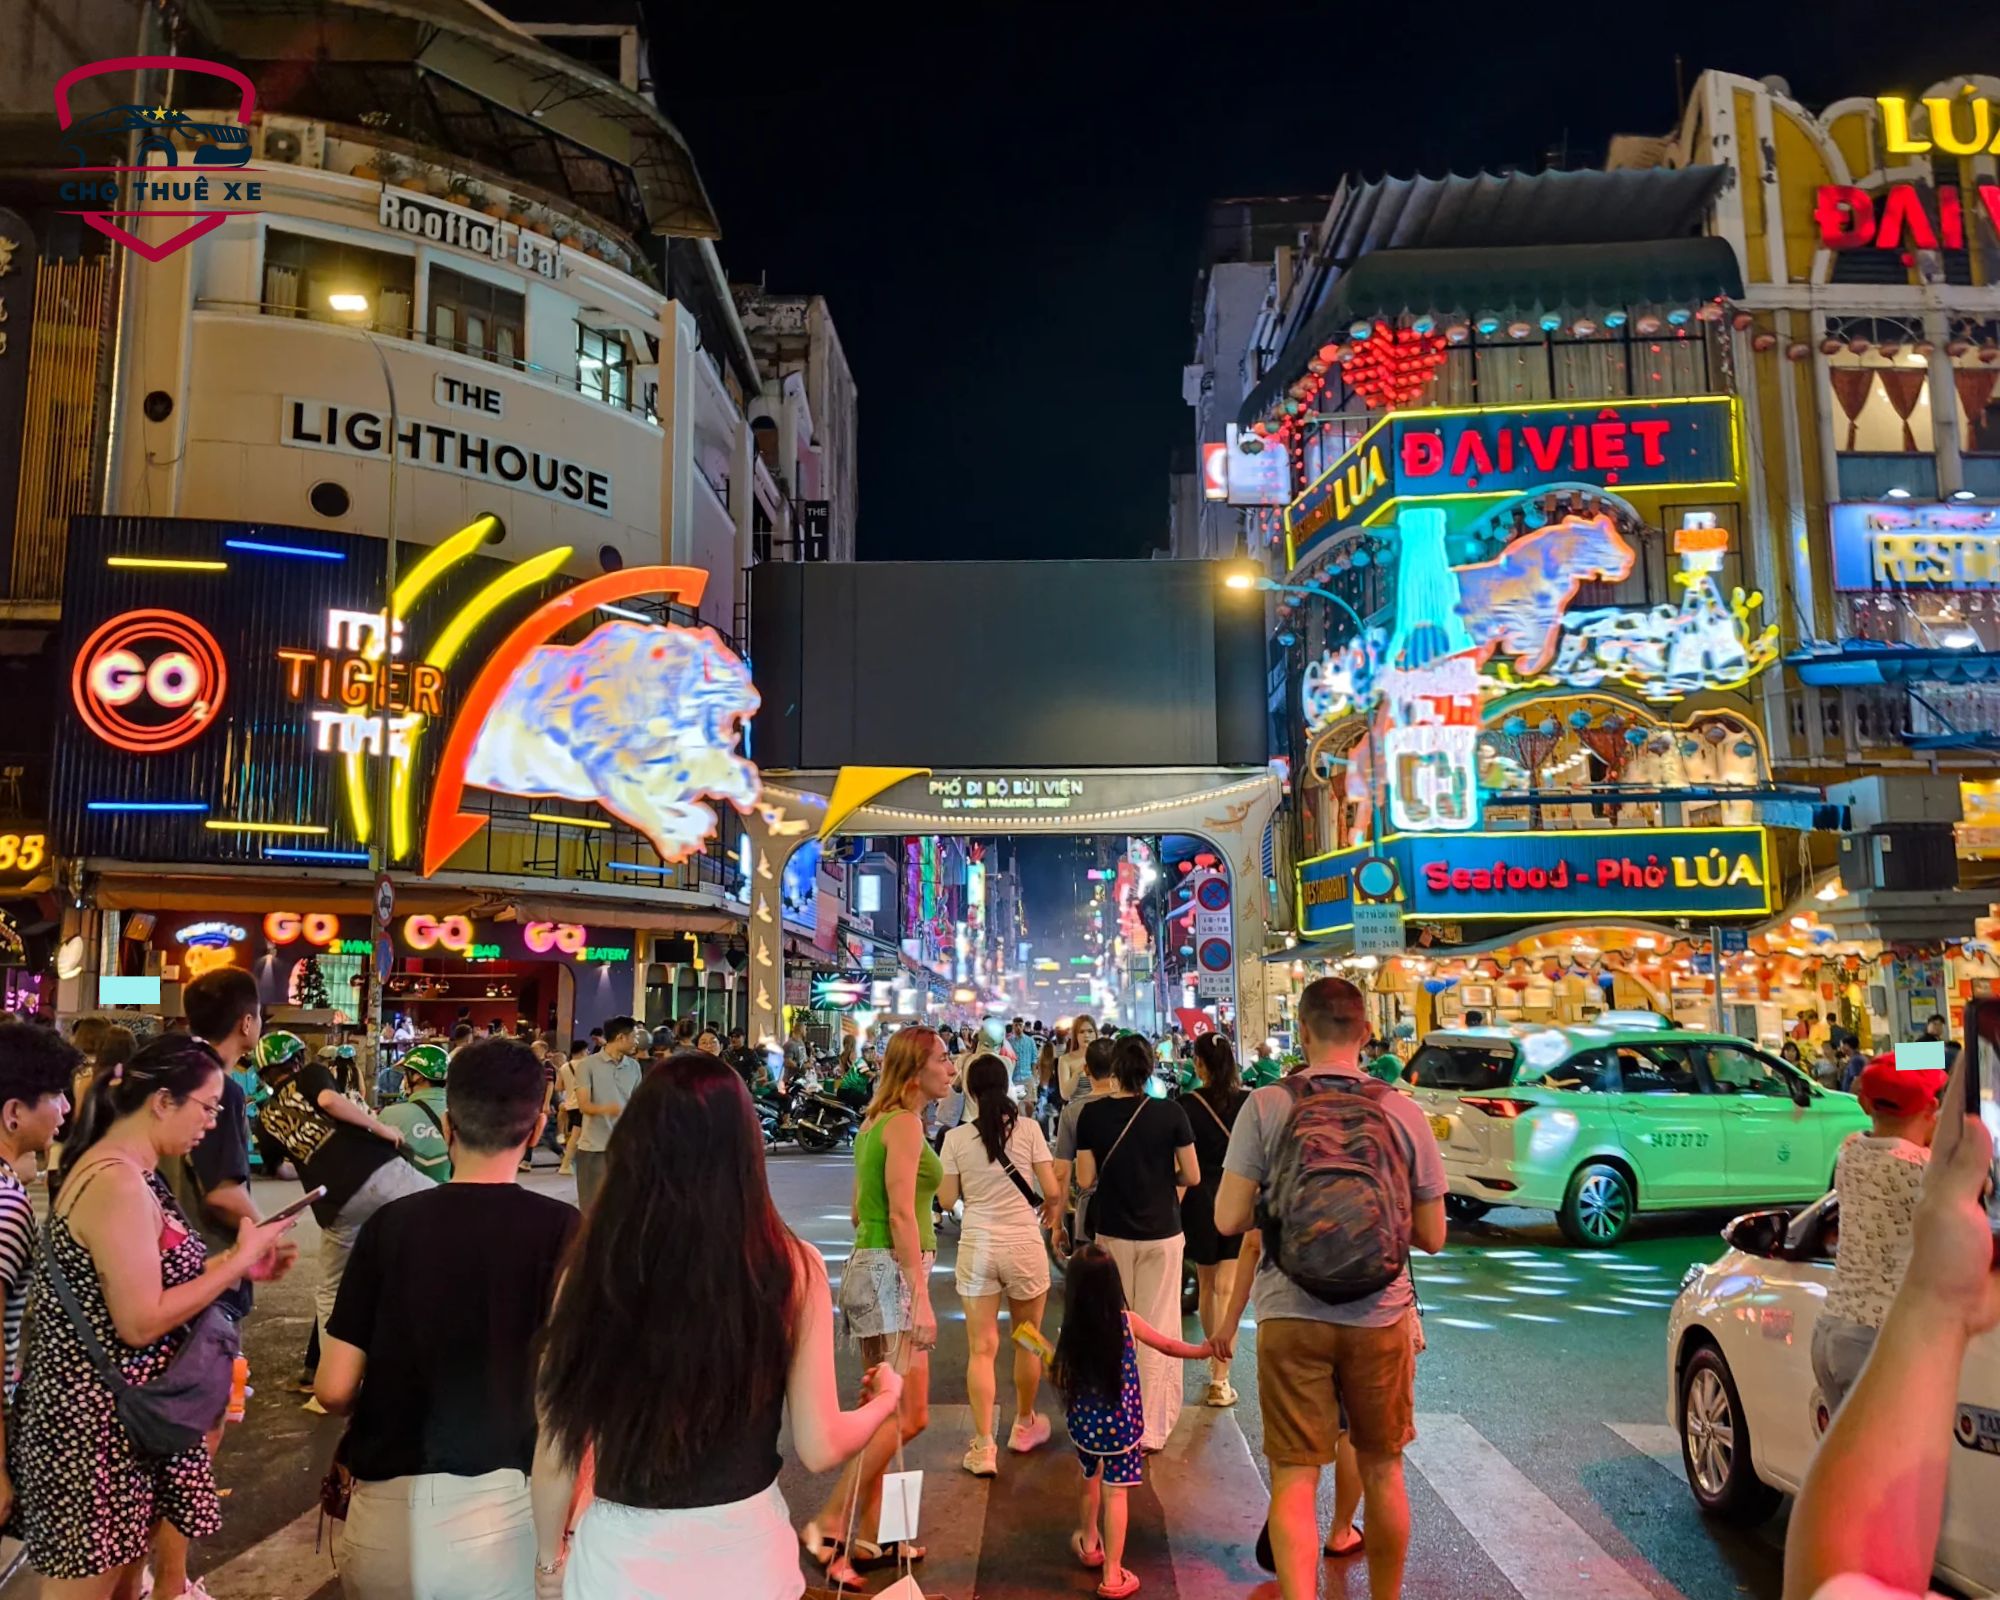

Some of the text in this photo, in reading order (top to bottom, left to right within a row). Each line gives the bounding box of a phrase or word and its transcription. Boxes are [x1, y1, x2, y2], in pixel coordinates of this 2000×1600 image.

[1876, 84, 2000, 155] LÚ
[379, 193, 566, 281] Rooftop Bar
[1814, 184, 1963, 268] ĐẠI
[443, 377, 501, 414] THE
[292, 402, 609, 510] LIGHTHOUSE
[1400, 407, 1671, 488] ĐẠI VIỆT
[807, 507, 828, 517] THE
[88, 649, 201, 708] GO
[276, 649, 444, 716] TIGER
[929, 776, 961, 795] PHỐ
[1012, 777, 1040, 795] BÙI
[1043, 778, 1083, 798] VIỆN
[1423, 859, 1570, 890] Seafood
[1597, 855, 1668, 889] Phở
[1671, 847, 1764, 888] LÚA
[264, 912, 340, 946] GO
[404, 914, 473, 950] GO
